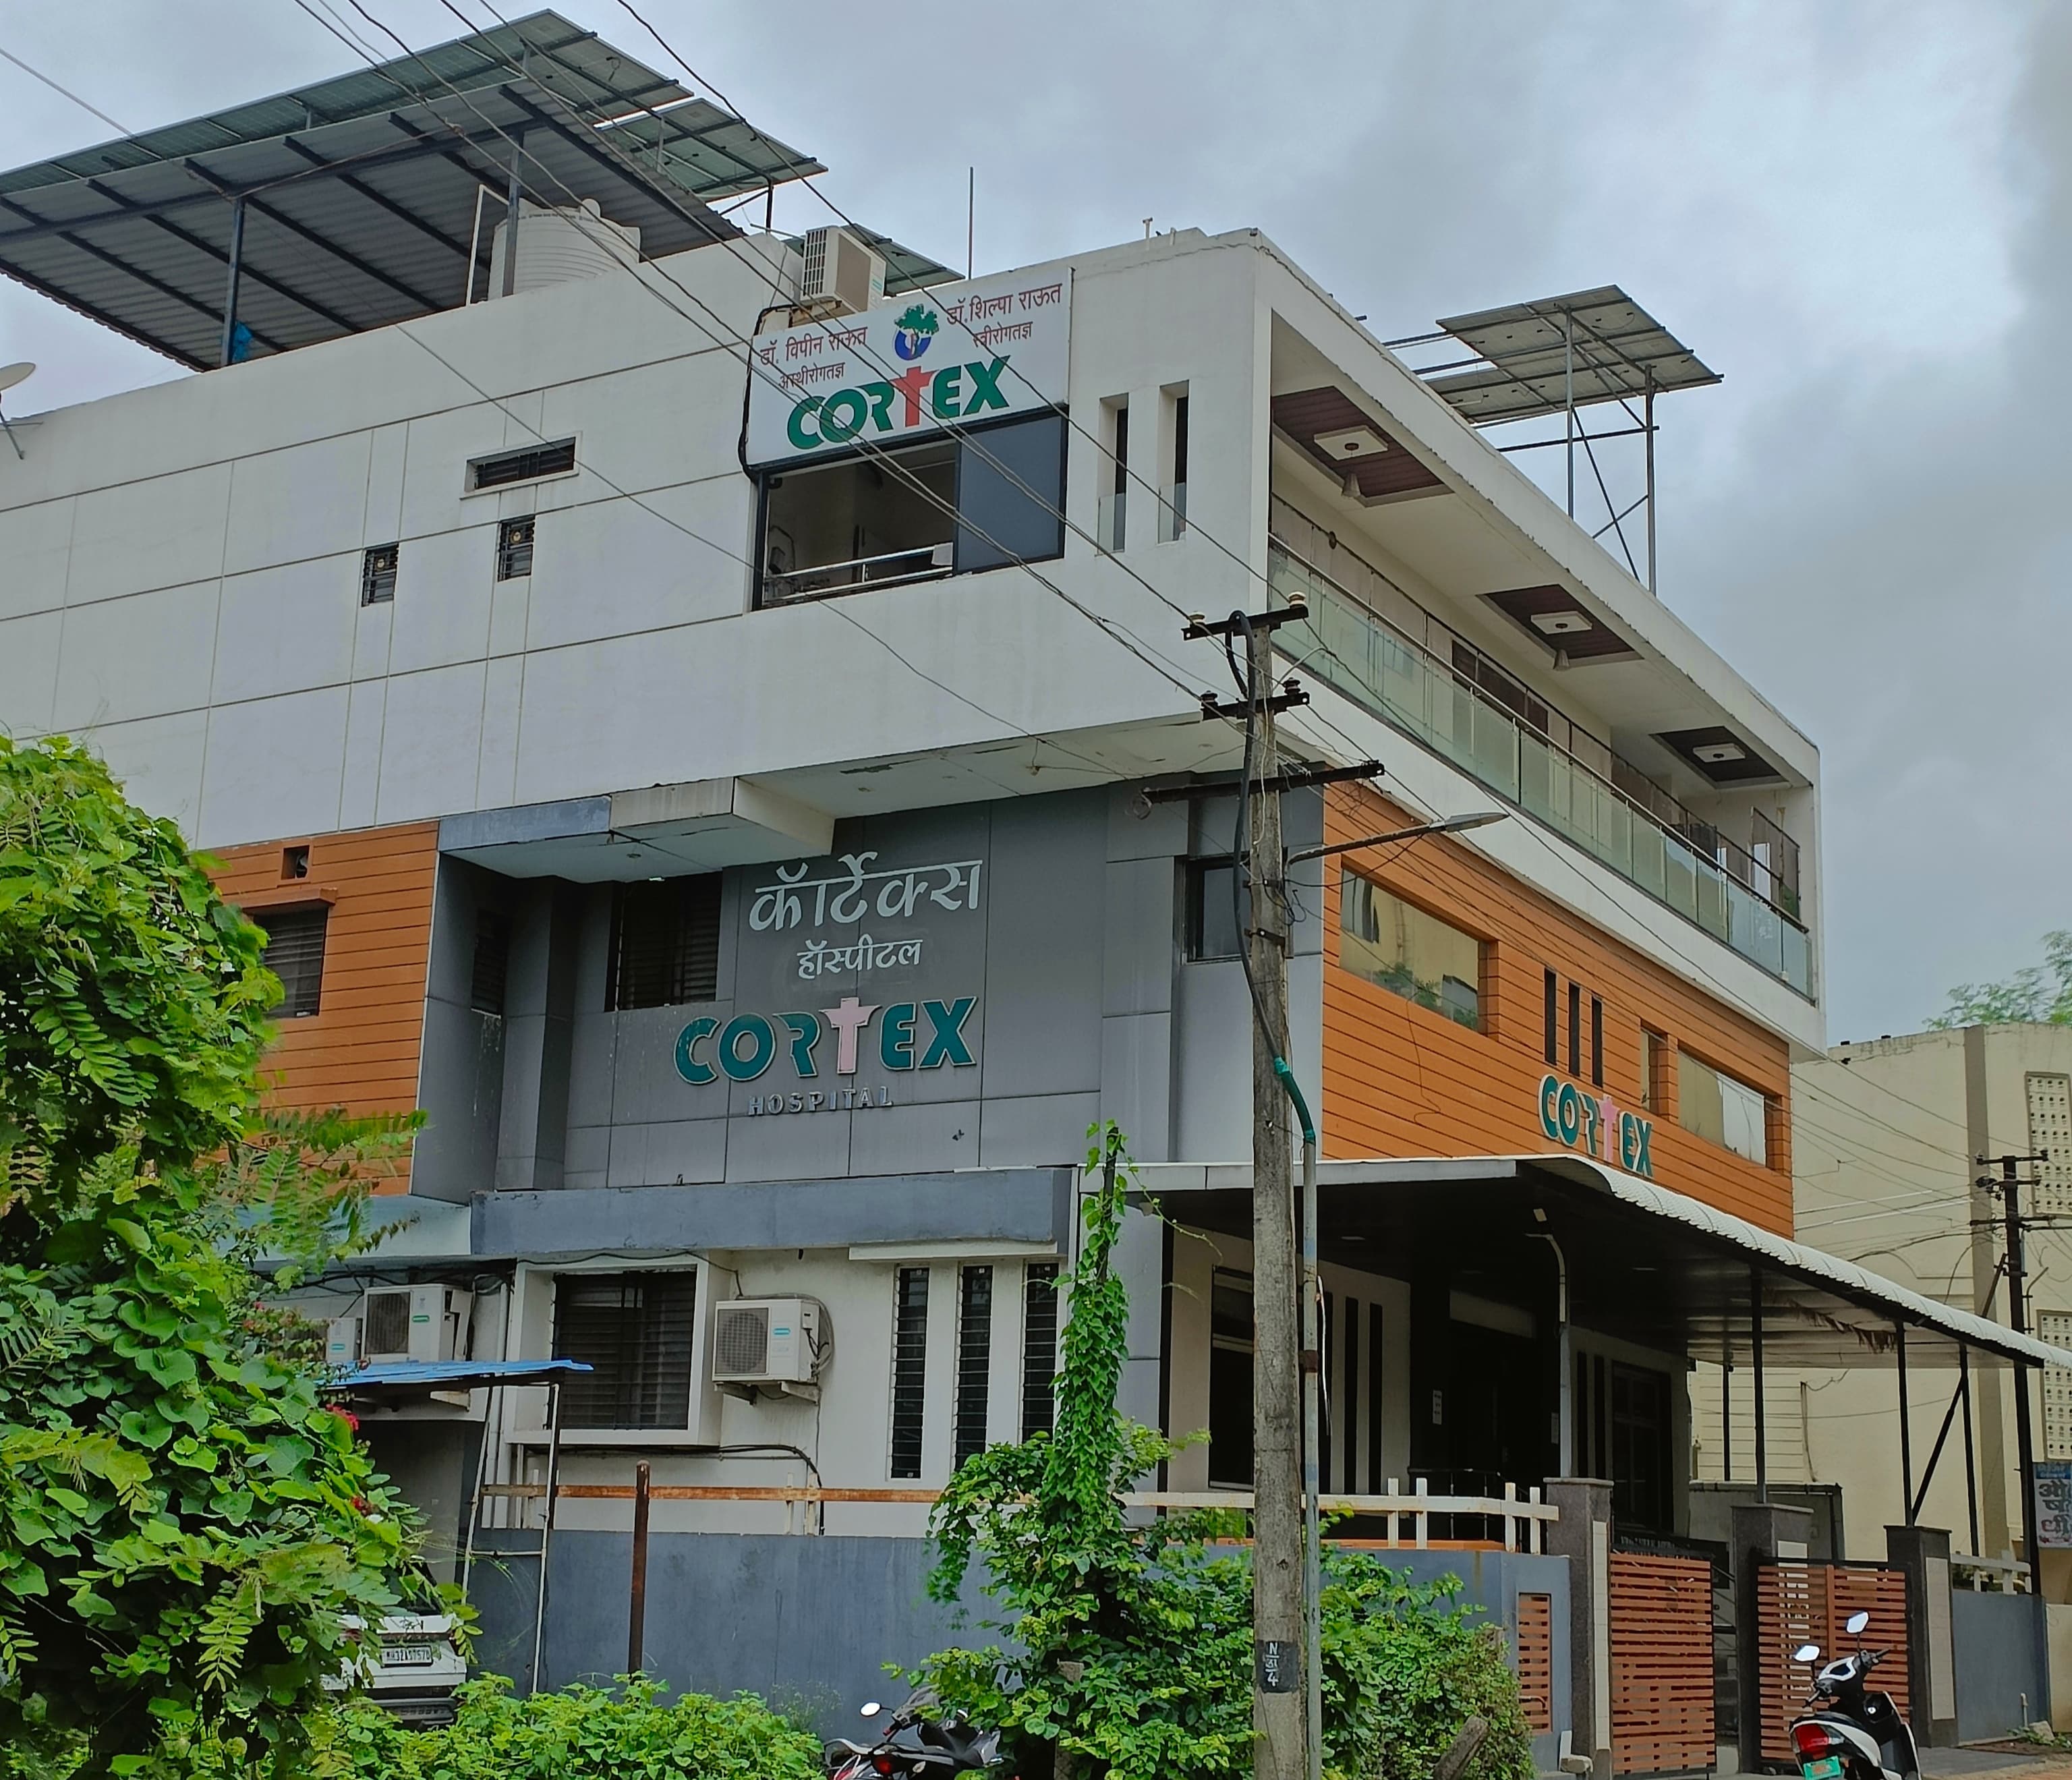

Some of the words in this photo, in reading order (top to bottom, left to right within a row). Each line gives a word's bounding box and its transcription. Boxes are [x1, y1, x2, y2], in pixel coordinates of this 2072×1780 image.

[1018, 283, 1062, 310] राऊत
[786, 333, 824, 362] विपीन
[786, 355, 1011, 450] CORTEX
[749, 851, 983, 931] कॉर्टेक्स
[797, 934, 923, 979] हॉस्पीटल
[674, 996, 977, 1085] CORTEX
[748, 1086, 893, 1116] HOSPITAL
[1538, 1074, 1654, 1178] CORTEX
[1269, 1642, 1278, 1655] N
[1267, 1672, 1279, 1686] 4
